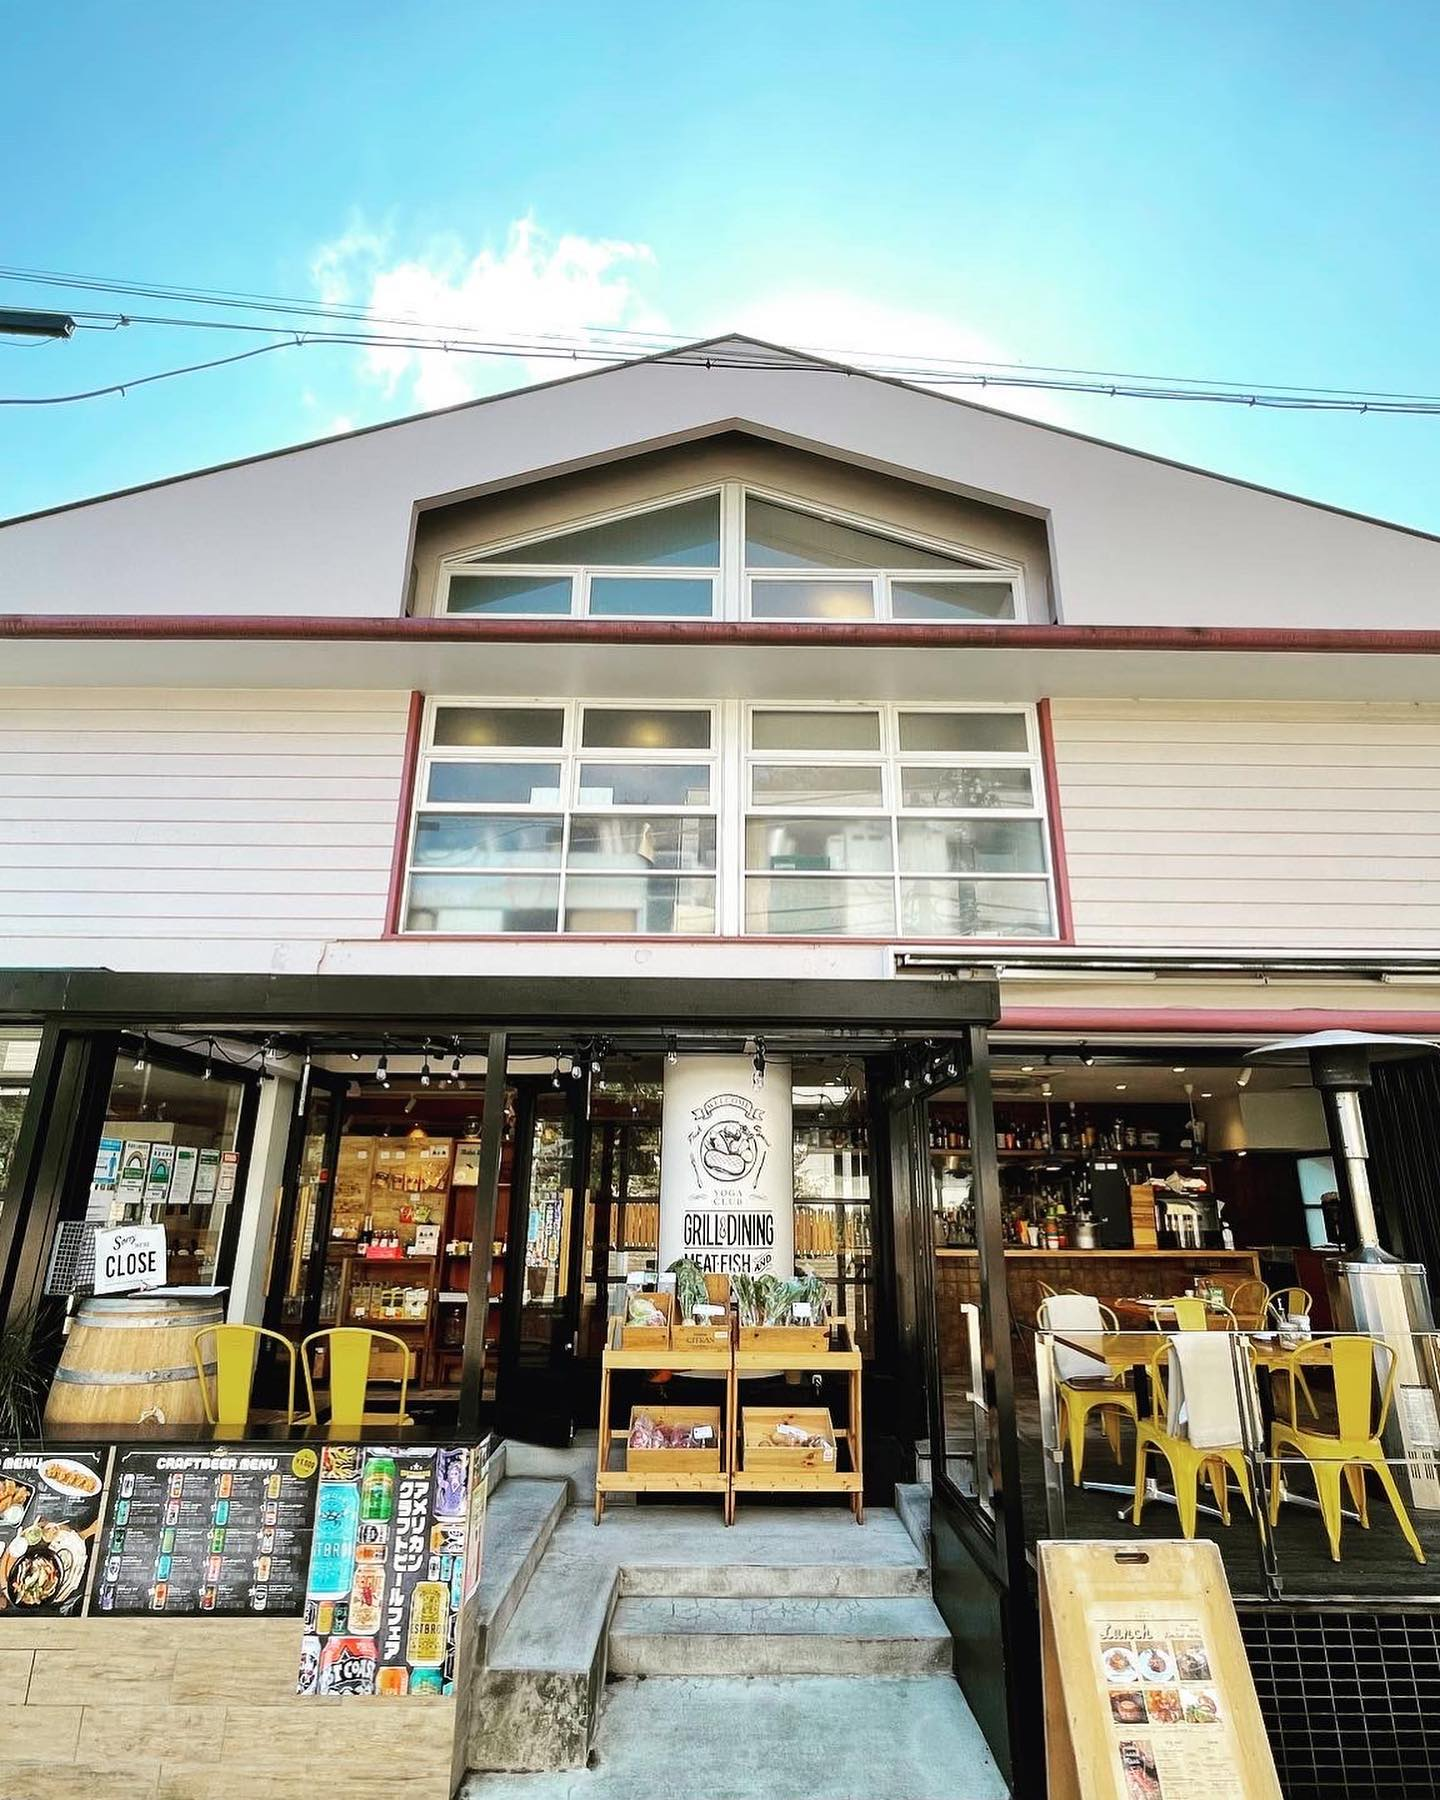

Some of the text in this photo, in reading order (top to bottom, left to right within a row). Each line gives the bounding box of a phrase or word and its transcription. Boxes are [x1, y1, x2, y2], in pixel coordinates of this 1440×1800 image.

[706, 1097, 750, 1109] WELCOME
[713, 1189, 742, 1197] YOGA
[106, 1251, 156, 1278] CLOSE
[2, 1457, 43, 1470] MENU
[156, 1457, 278, 1470] CRAFTBEER MENU
[407, 1482, 430, 1571] アメリカン
[384, 1482, 414, 1661] クラフトビールフェア
[1099, 1623, 1154, 1640] Lunch
